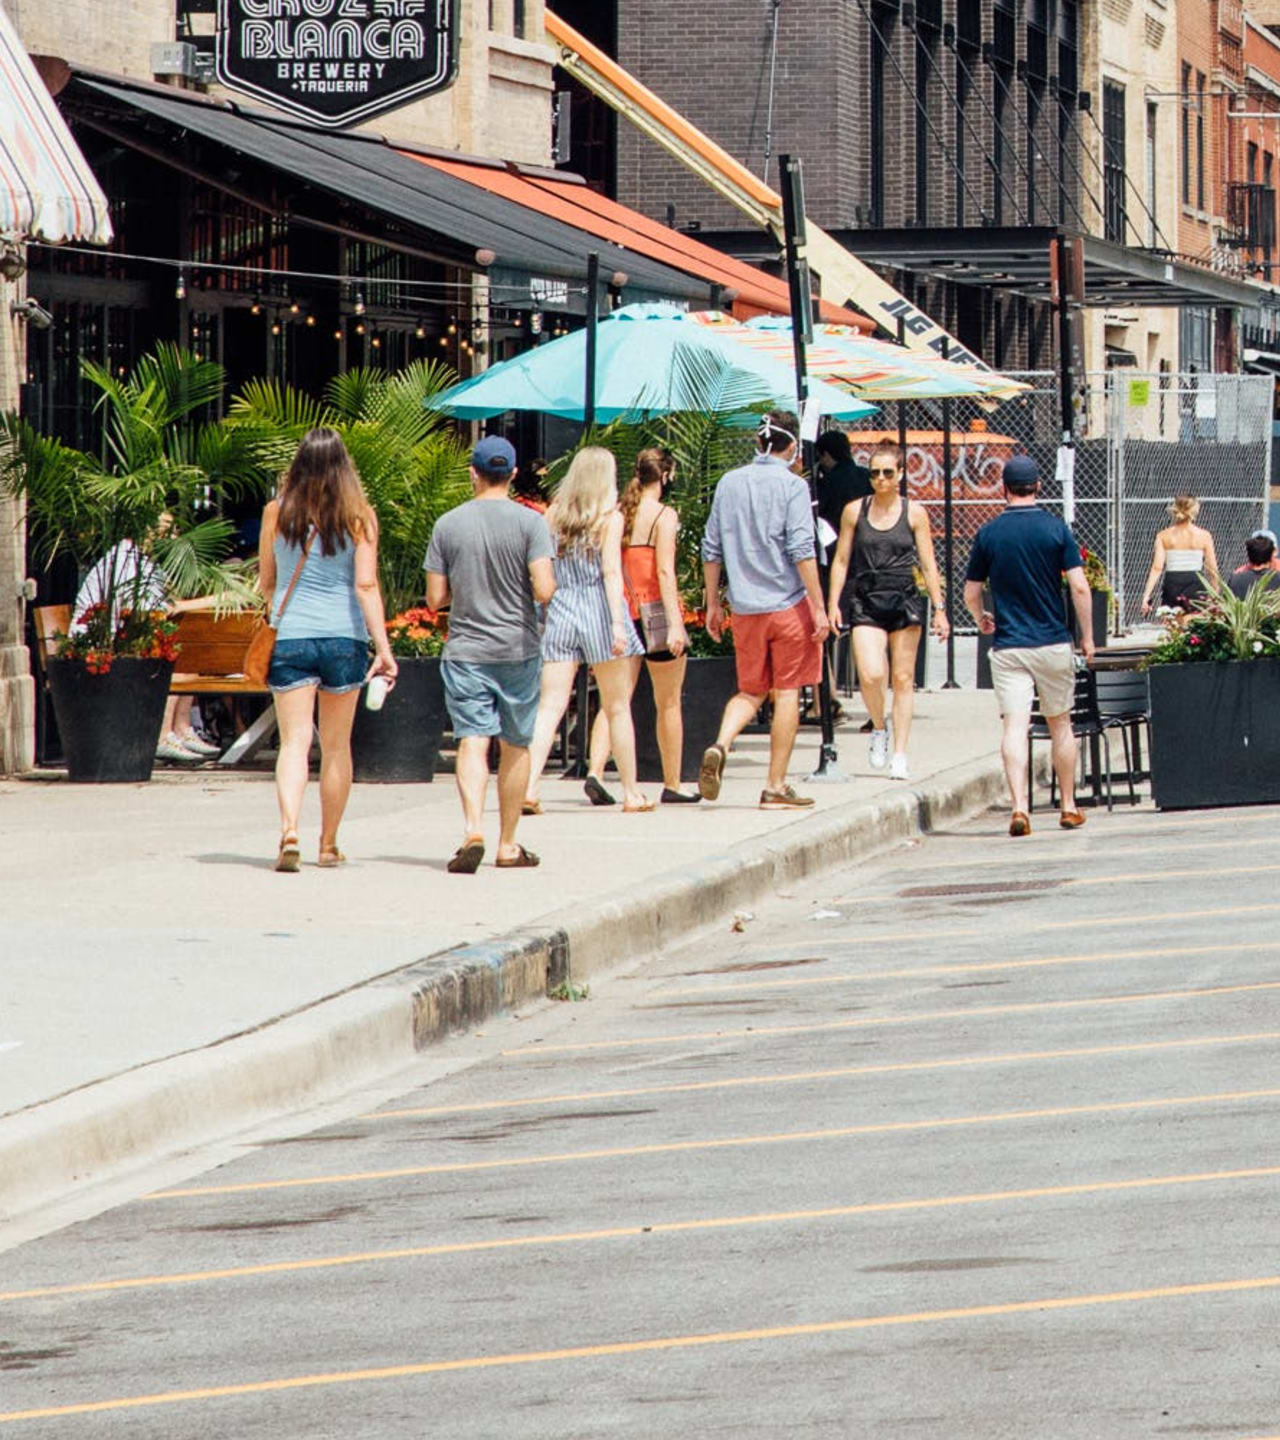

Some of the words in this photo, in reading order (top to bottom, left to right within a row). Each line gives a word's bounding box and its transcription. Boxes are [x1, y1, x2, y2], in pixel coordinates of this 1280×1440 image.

[241, 19, 425, 59] BLANCA
[277, 63, 386, 79] BREWERY
[878, 298, 934, 336] JLG
